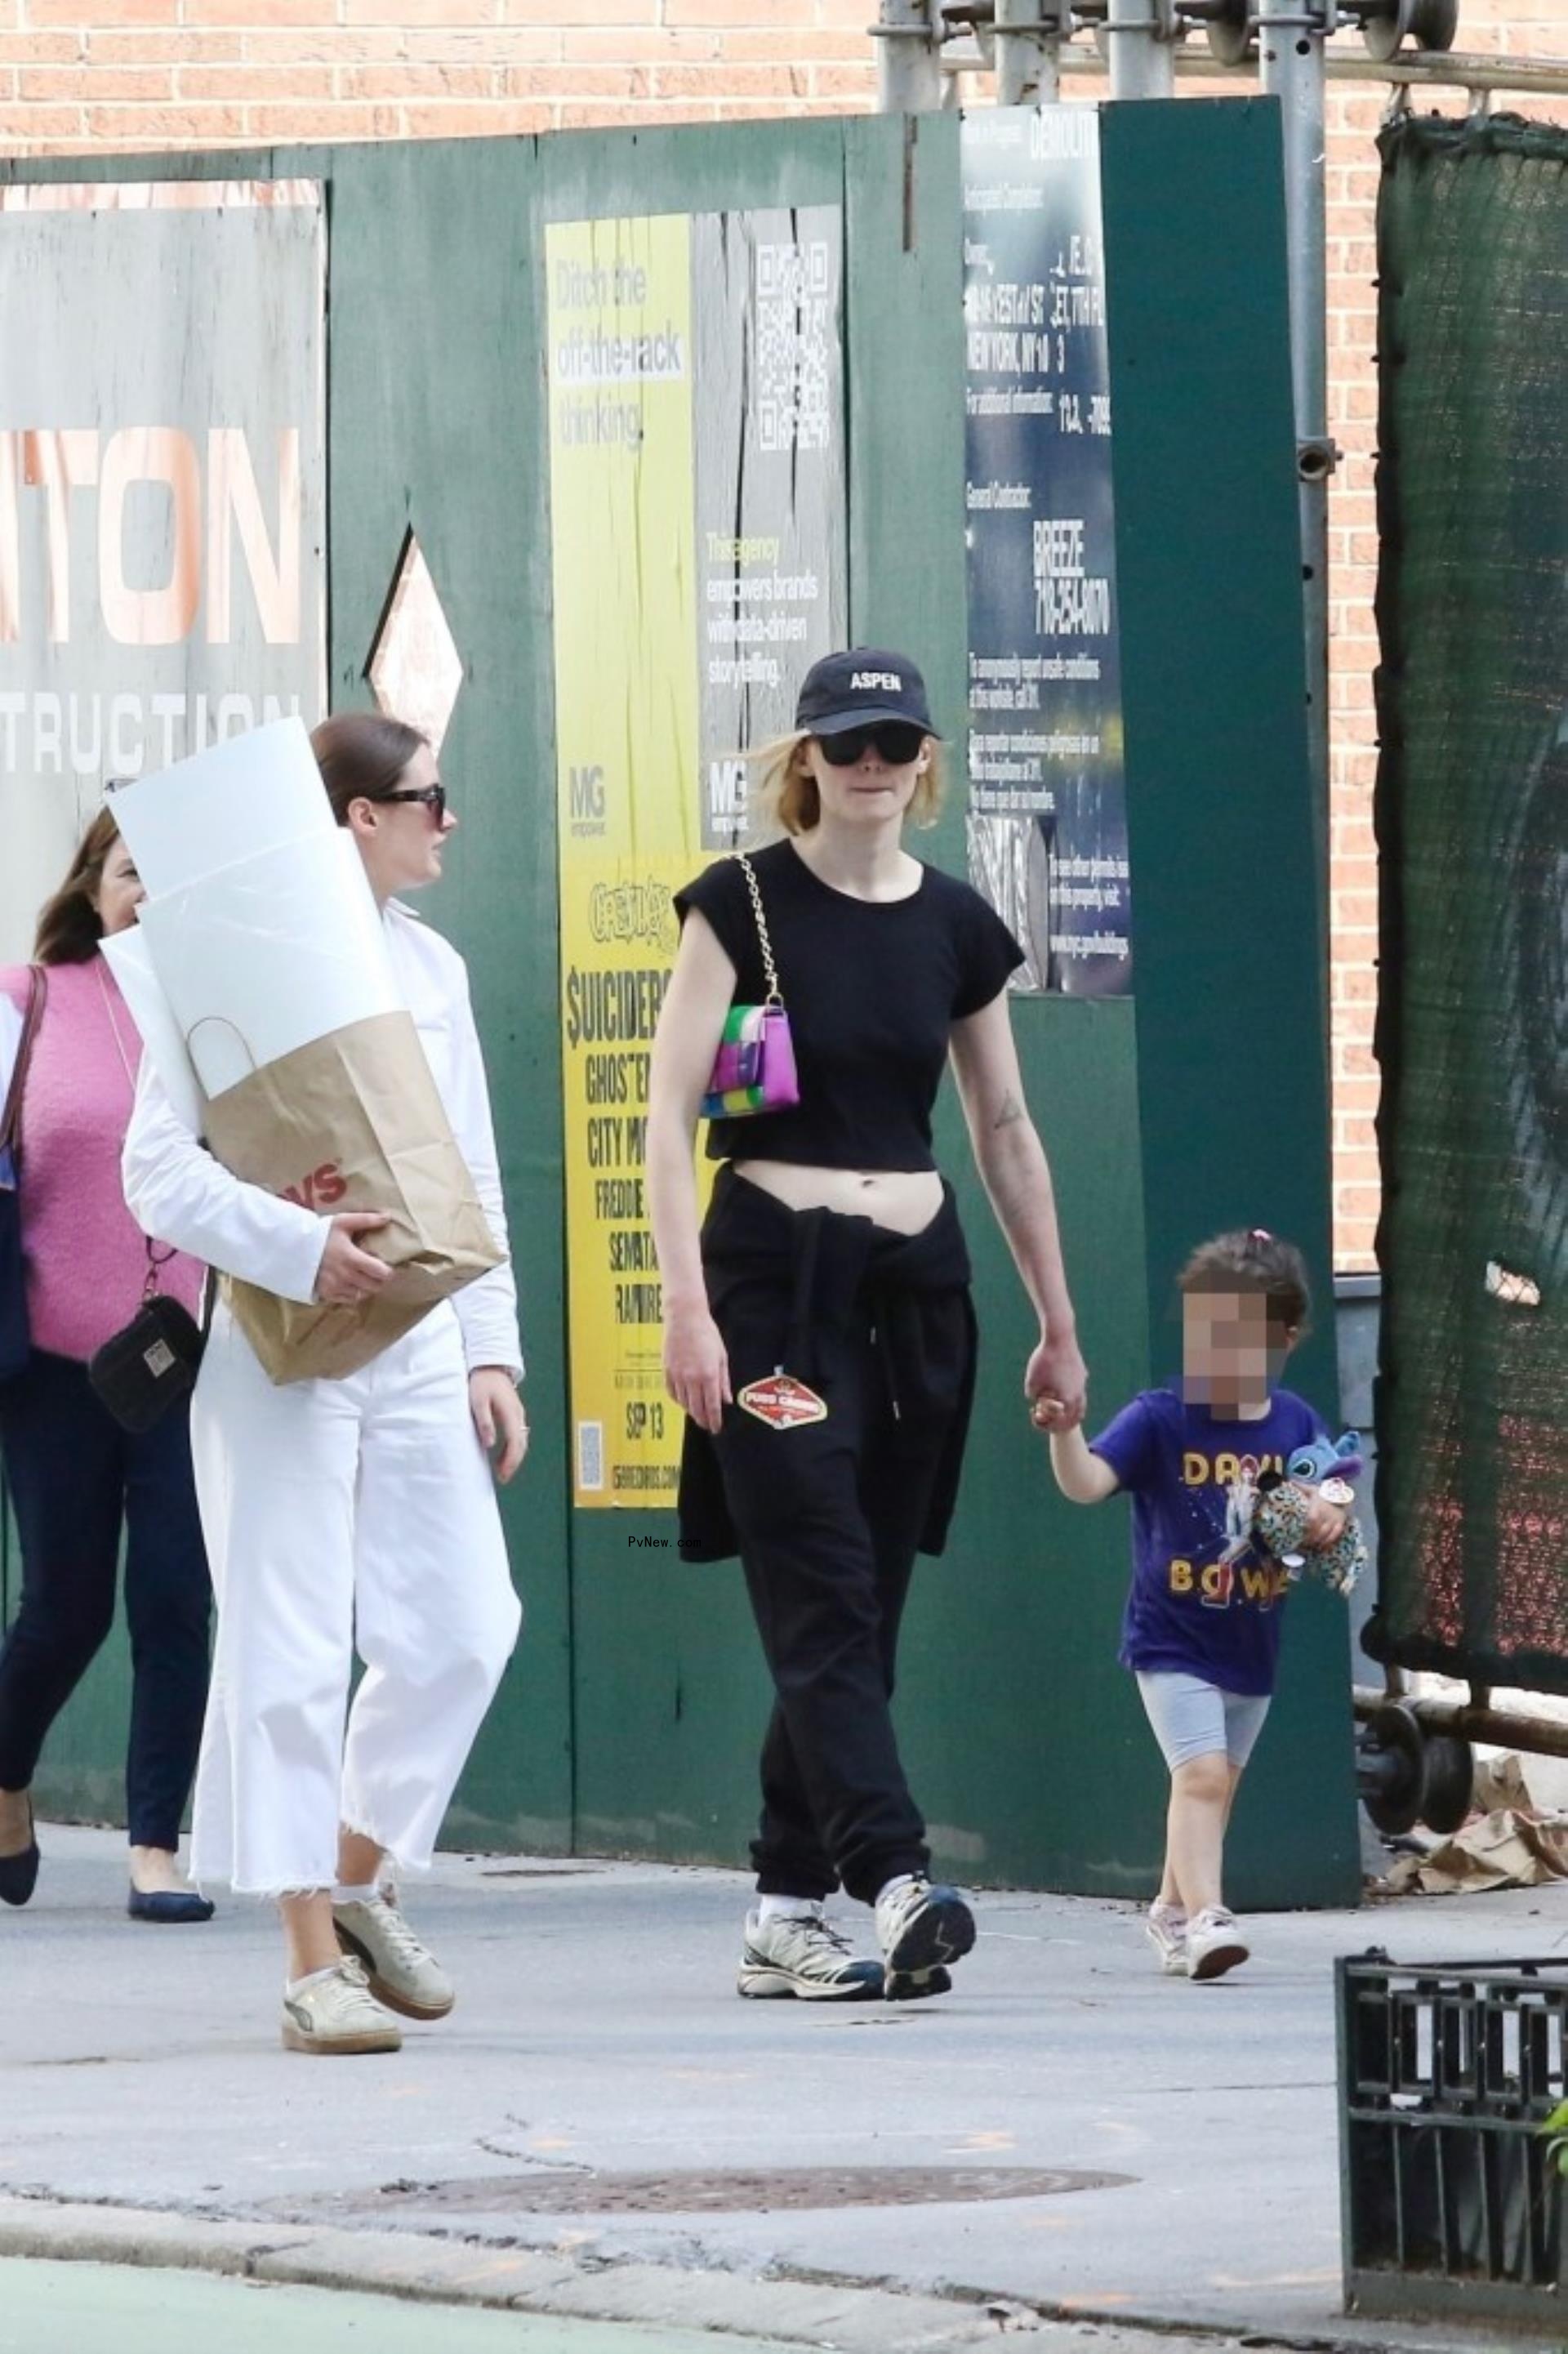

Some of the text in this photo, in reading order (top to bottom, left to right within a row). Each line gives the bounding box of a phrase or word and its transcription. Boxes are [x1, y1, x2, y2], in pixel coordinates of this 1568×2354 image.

[557, 256, 647, 309] Ditch the
[558, 319, 681, 377] off-the-rack
[1033, 519, 1085, 577] BREEZE
[706, 568, 818, 610] empowers brands
[850, 671, 902, 691] ASPEN
[0, 693, 301, 774] TRUCTIO
[570, 766, 604, 818] MG
[713, 760, 747, 814] MG
[586, 1053, 651, 1104] GHOSTE
[588, 1116, 622, 1167] CITY
[650, 1402, 664, 1439] 13
